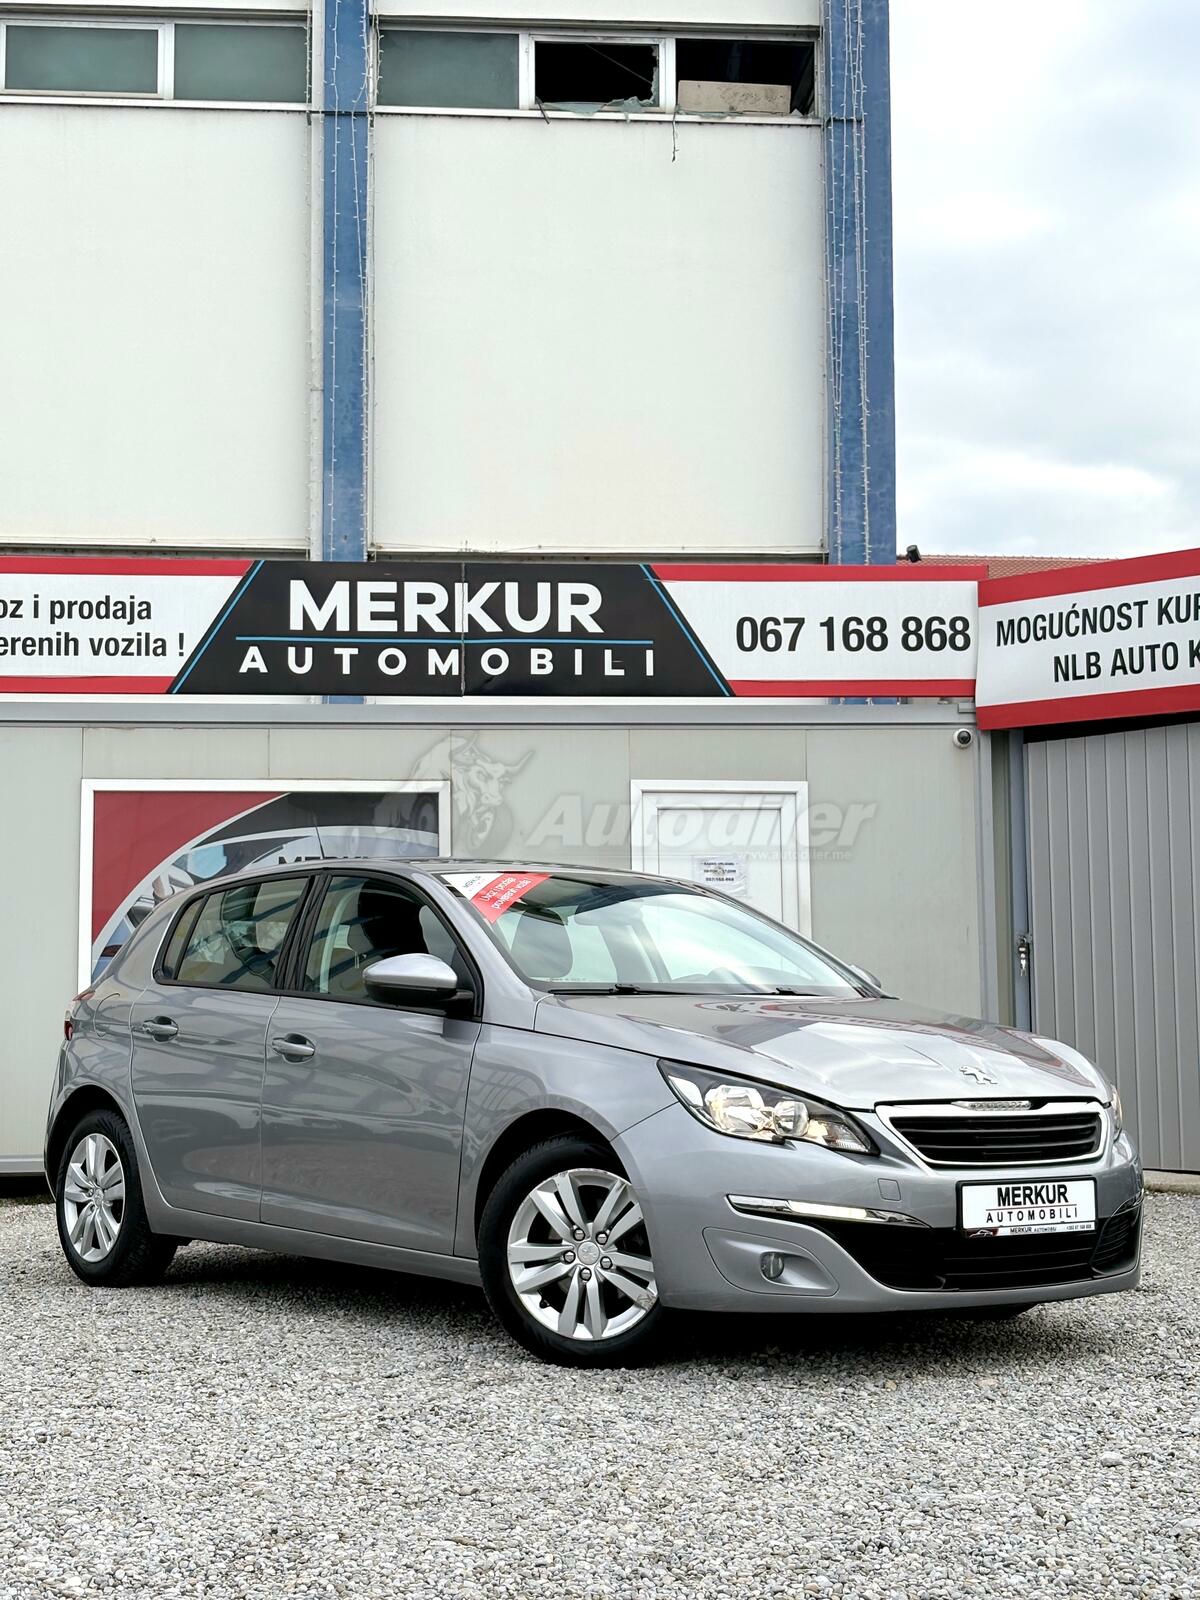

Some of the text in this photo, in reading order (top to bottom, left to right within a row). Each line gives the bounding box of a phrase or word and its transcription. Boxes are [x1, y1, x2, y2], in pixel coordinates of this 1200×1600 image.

[33, 594, 39, 618] i
[50, 595, 152, 625] prodaja
[289, 579, 604, 633] MERKUR
[735, 616, 971, 652] 067 168 868
[996, 600, 1148, 647] MOGUĆNOST
[89, 632, 167, 657] vozila
[239, 645, 655, 676] AUTOMOBILI
[1053, 651, 1101, 683] NLB
[1110, 641, 1179, 677] AUTO
[997, 1184, 1069, 1207] MERKUR
[986, 1207, 1077, 1223] AUTOMOBILI
